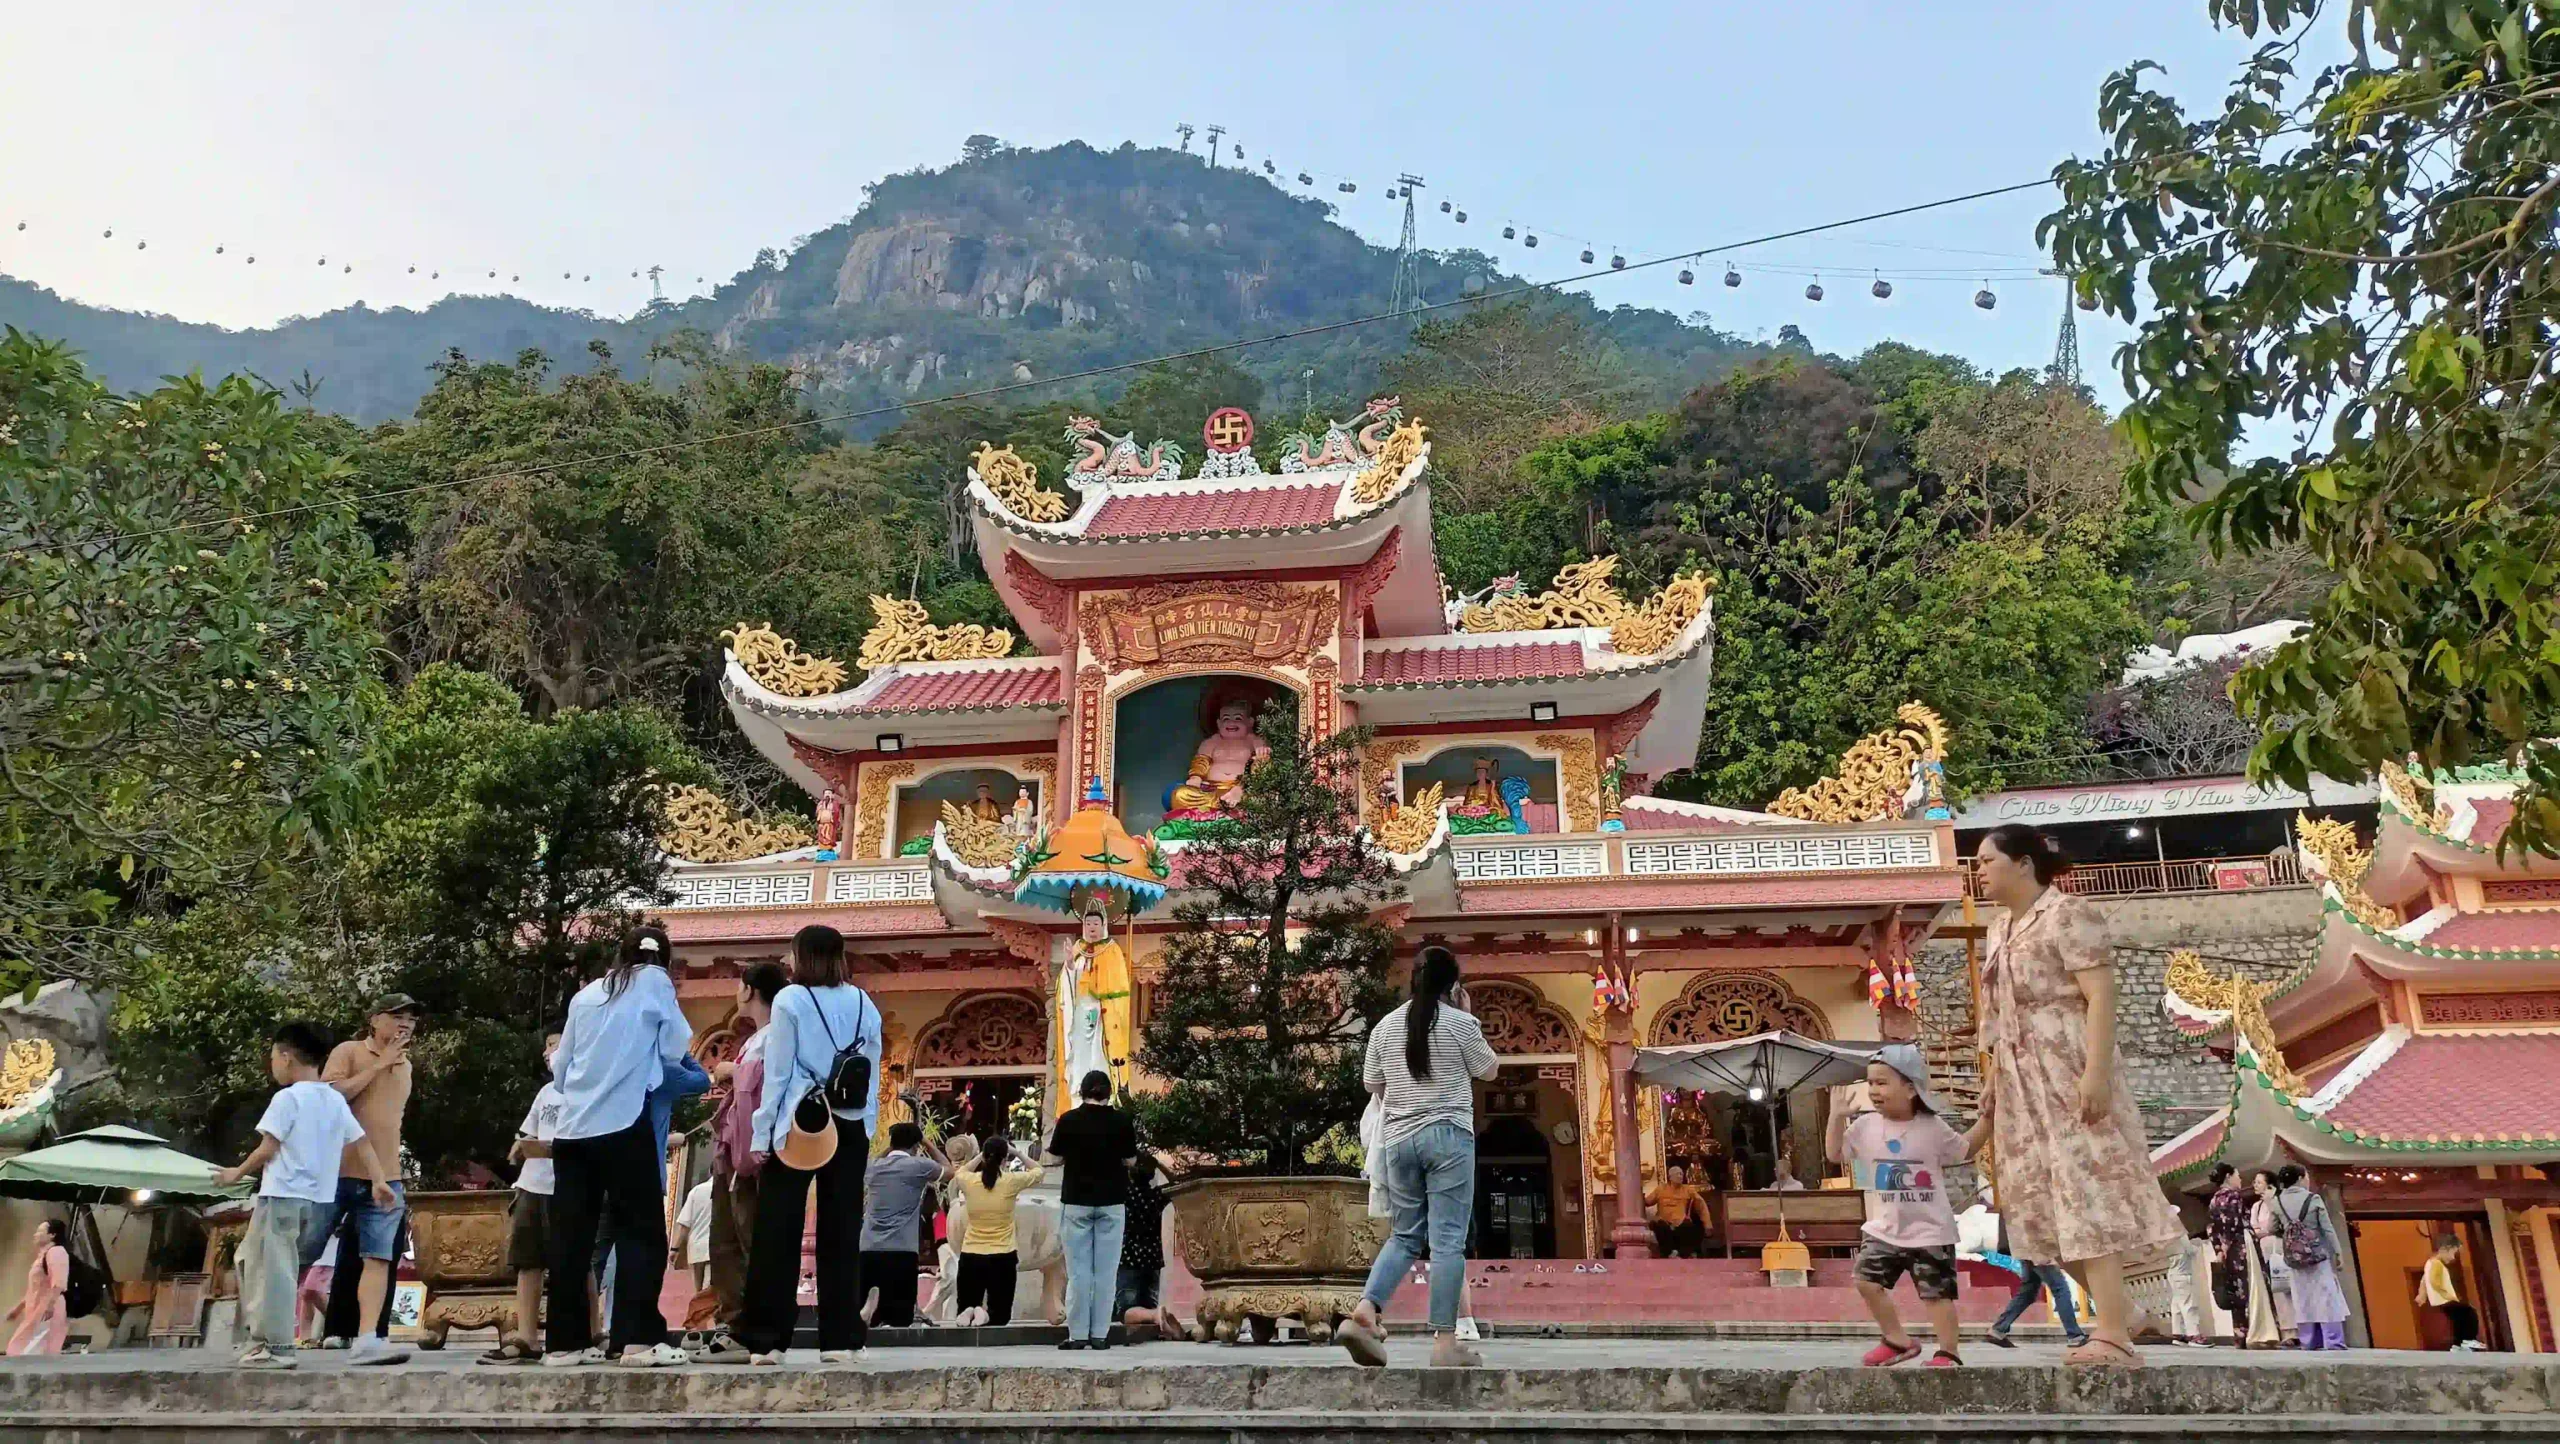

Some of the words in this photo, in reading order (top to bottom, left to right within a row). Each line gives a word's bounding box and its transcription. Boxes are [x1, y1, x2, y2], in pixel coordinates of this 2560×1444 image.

[1158, 626, 1178, 645] LINH
[1217, 620, 1245, 638] THẠCH
[1899, 1191, 1917, 1203] ALL
